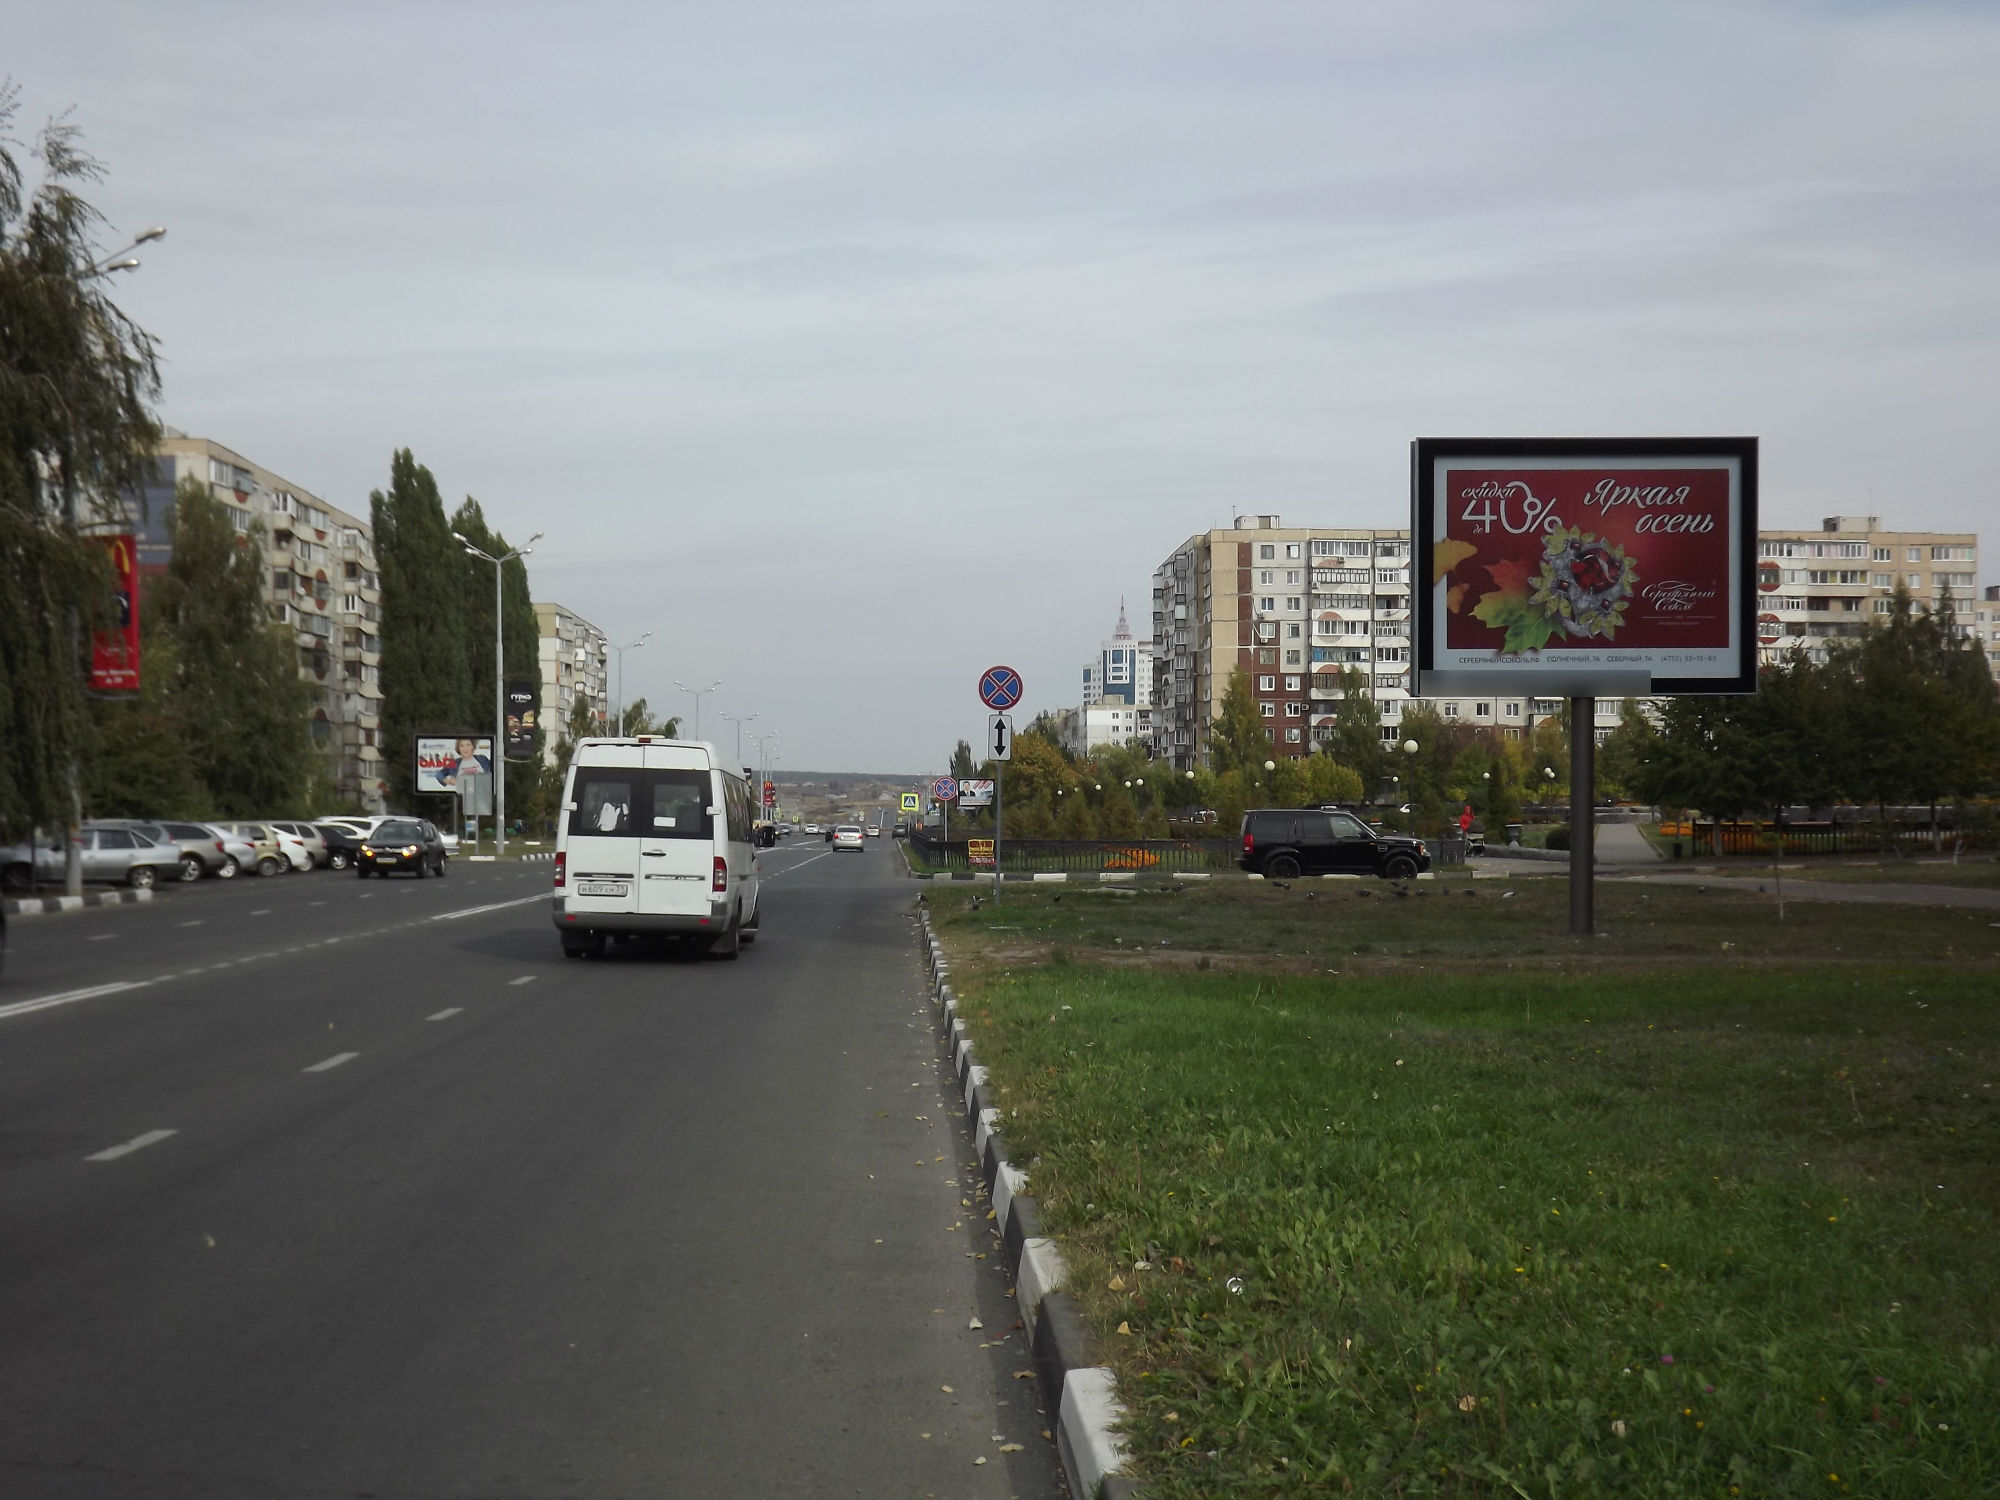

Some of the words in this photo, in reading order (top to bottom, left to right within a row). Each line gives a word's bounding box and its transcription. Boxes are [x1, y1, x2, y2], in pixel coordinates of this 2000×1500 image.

[1461, 481, 1517, 500] скидки
[1583, 478, 1691, 517] Яркая
[1461, 480, 1563, 534] 40%
[1634, 513, 1715, 534] осень
